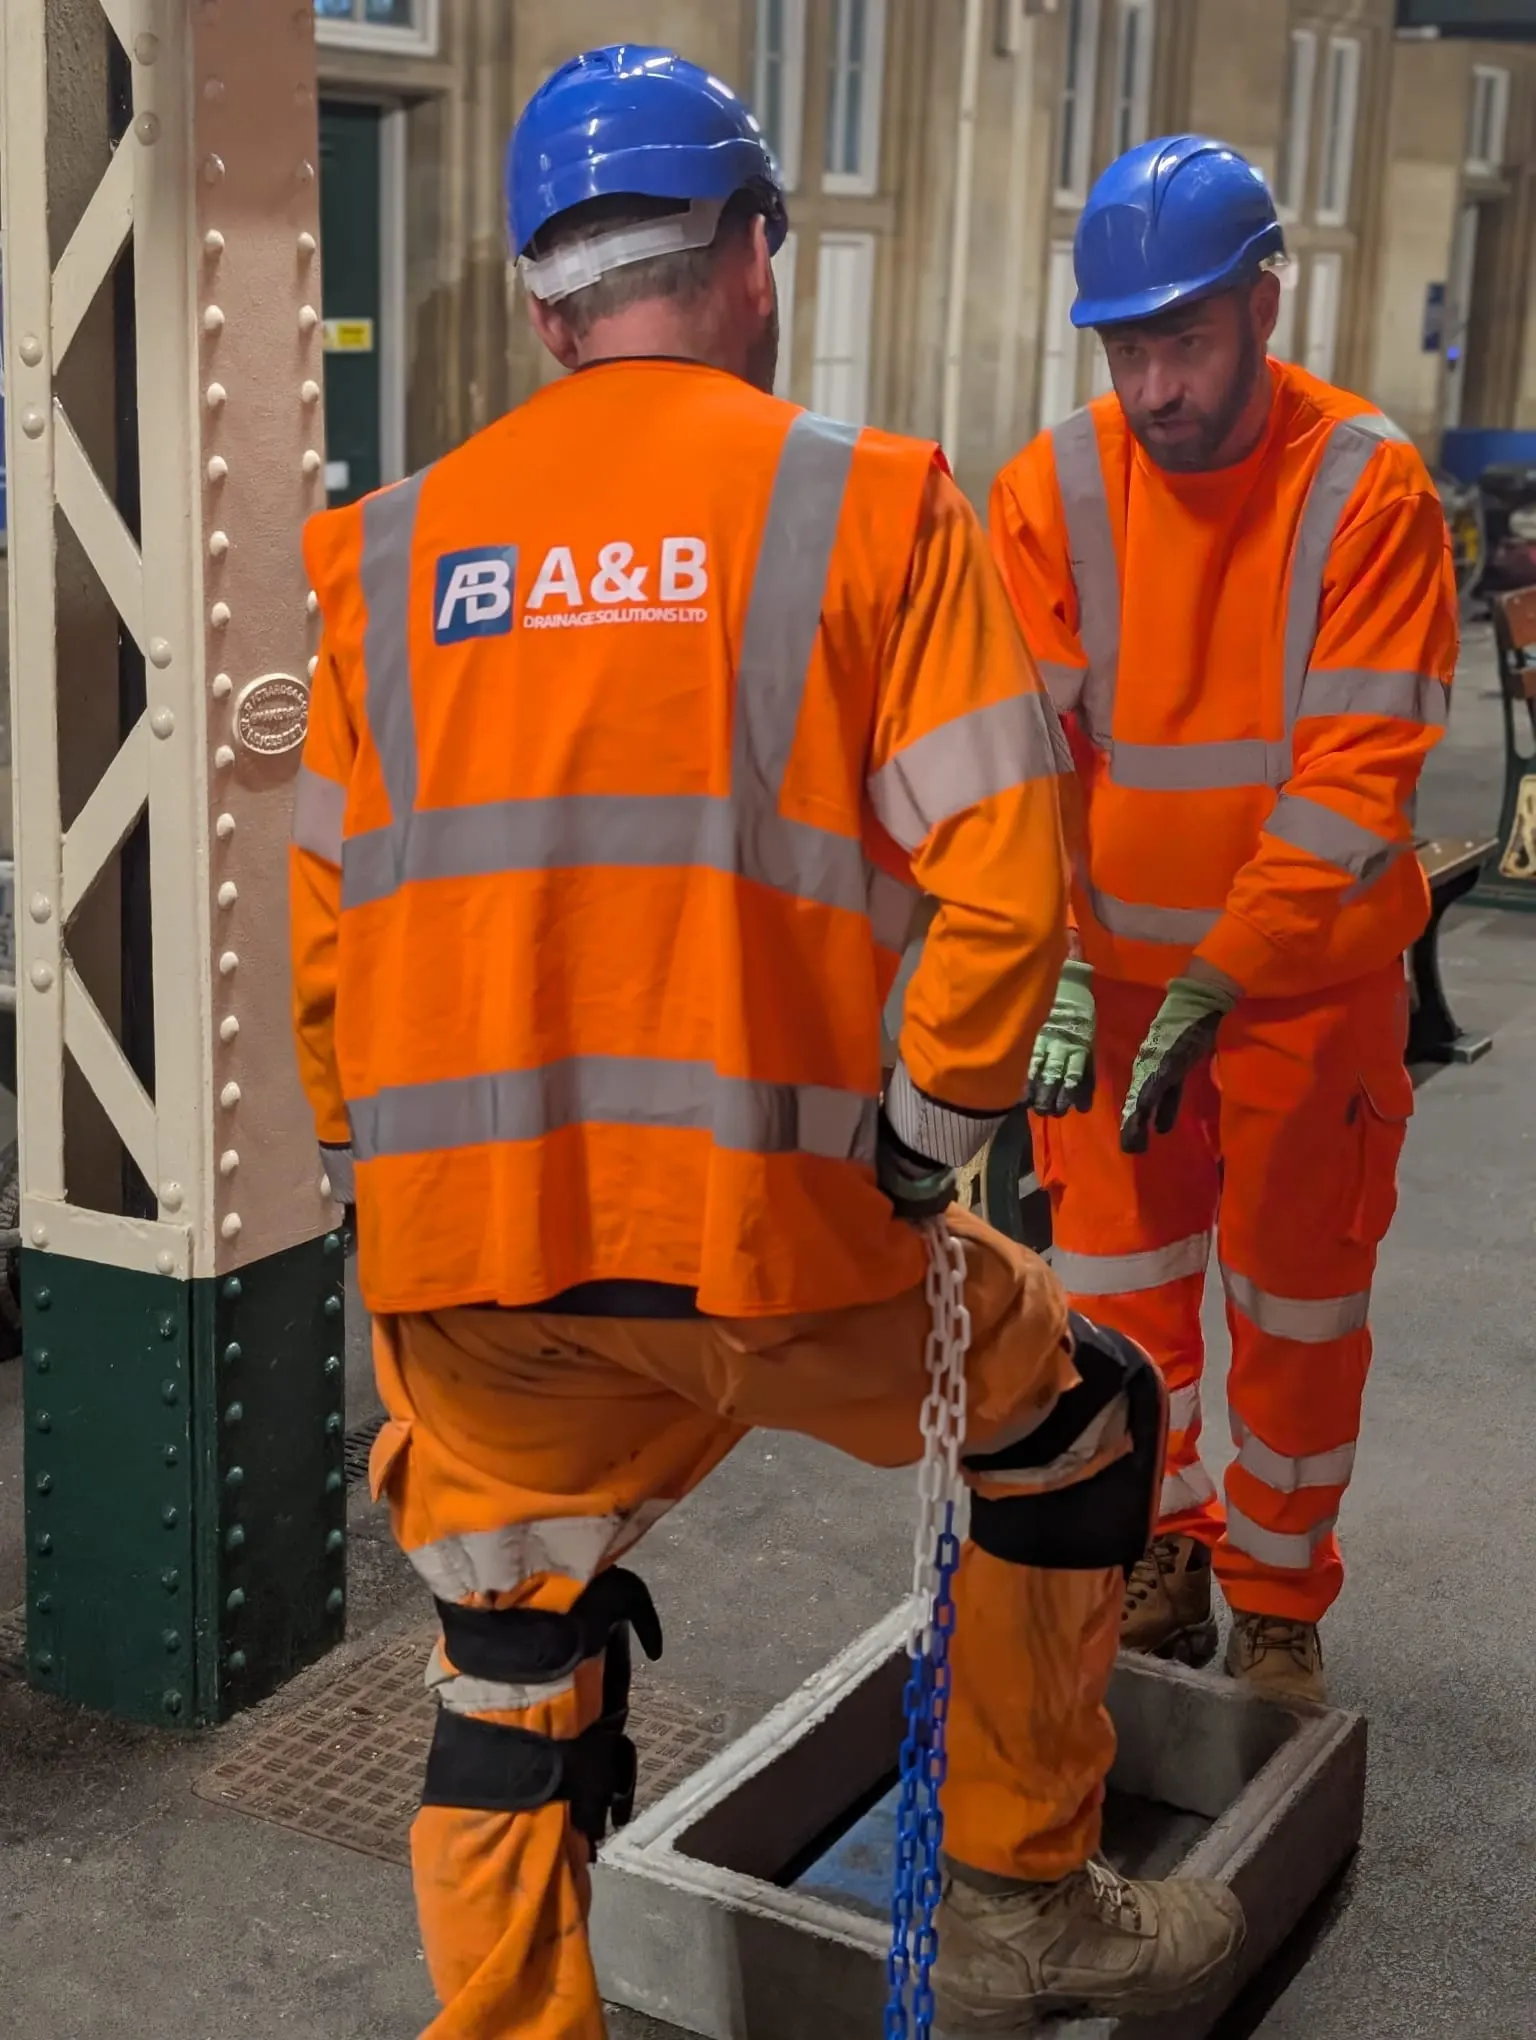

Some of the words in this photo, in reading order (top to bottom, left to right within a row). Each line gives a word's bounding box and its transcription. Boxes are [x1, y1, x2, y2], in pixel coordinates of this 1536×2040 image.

[437, 559, 511, 631] AB
[526, 546, 583, 609] A
[589, 541, 648, 604] &
[659, 536, 708, 602] B
[678, 607, 708, 622] LTD
